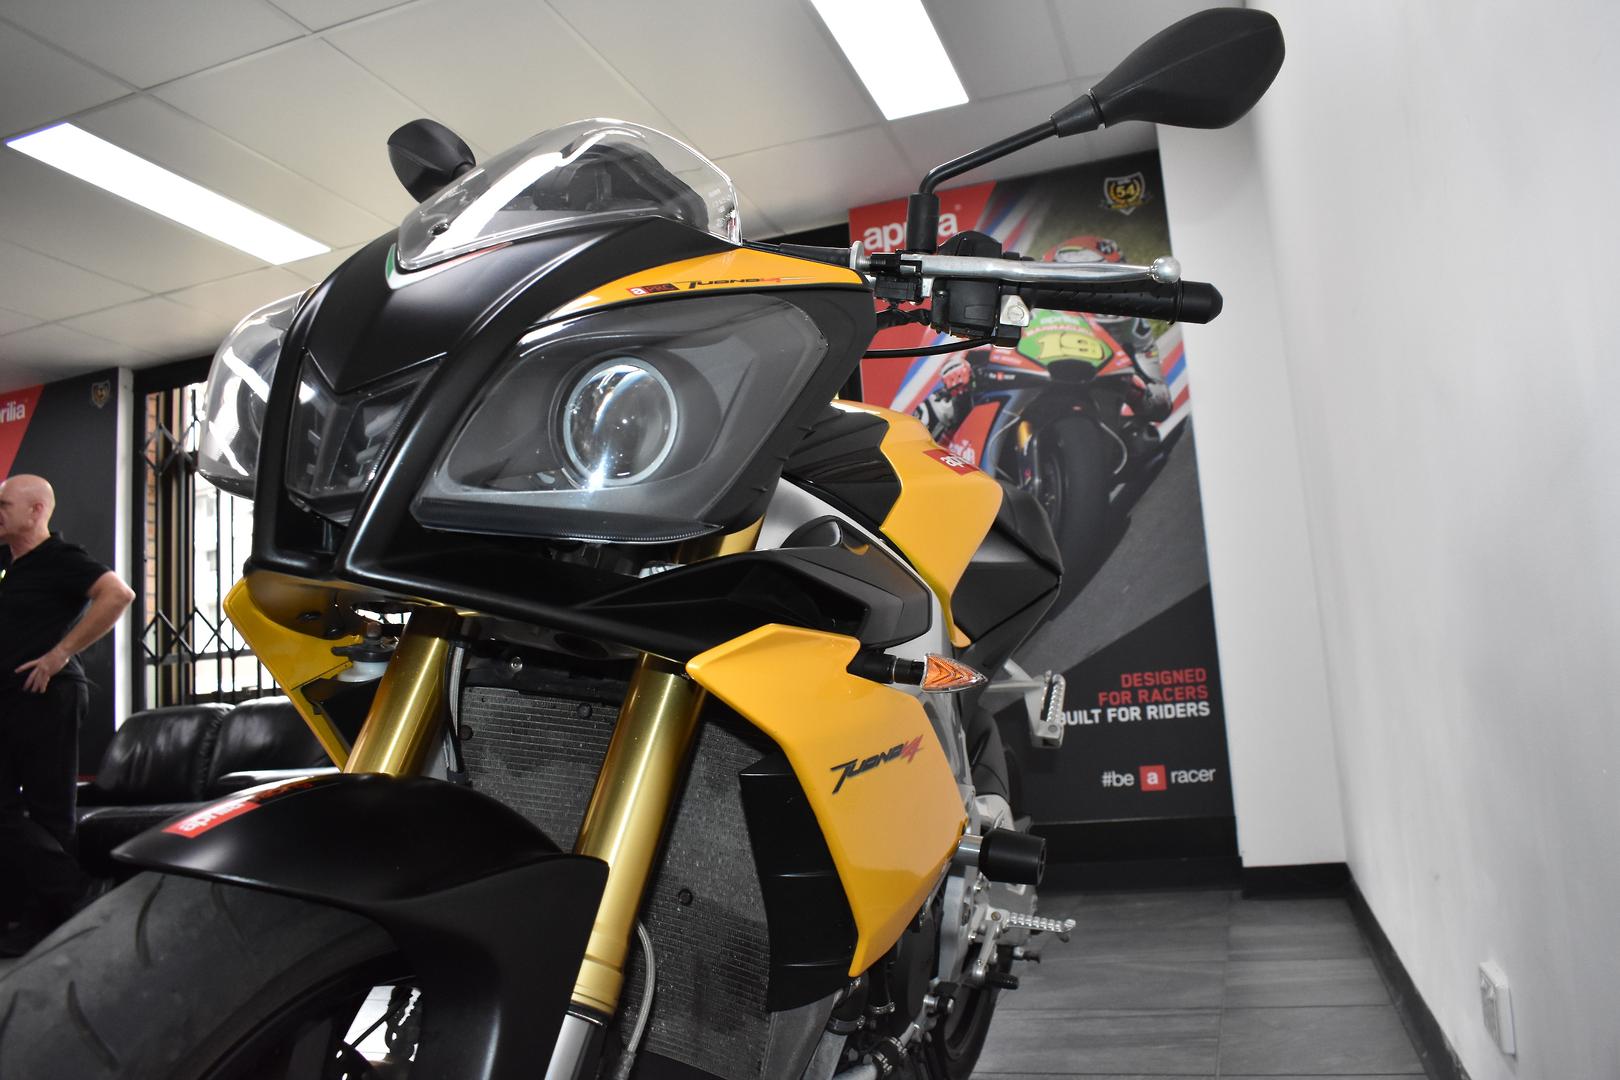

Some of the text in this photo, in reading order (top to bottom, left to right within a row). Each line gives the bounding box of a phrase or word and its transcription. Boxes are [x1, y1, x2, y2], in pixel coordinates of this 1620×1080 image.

[1121, 668, 1207, 688] DESIGNED
[1098, 685, 1209, 706] FOR RACERS
[1107, 706, 1142, 723] FOR
[1147, 701, 1211, 721] RIDERS
[1101, 770, 1135, 788] #be
[1170, 768, 1217, 784] racer
